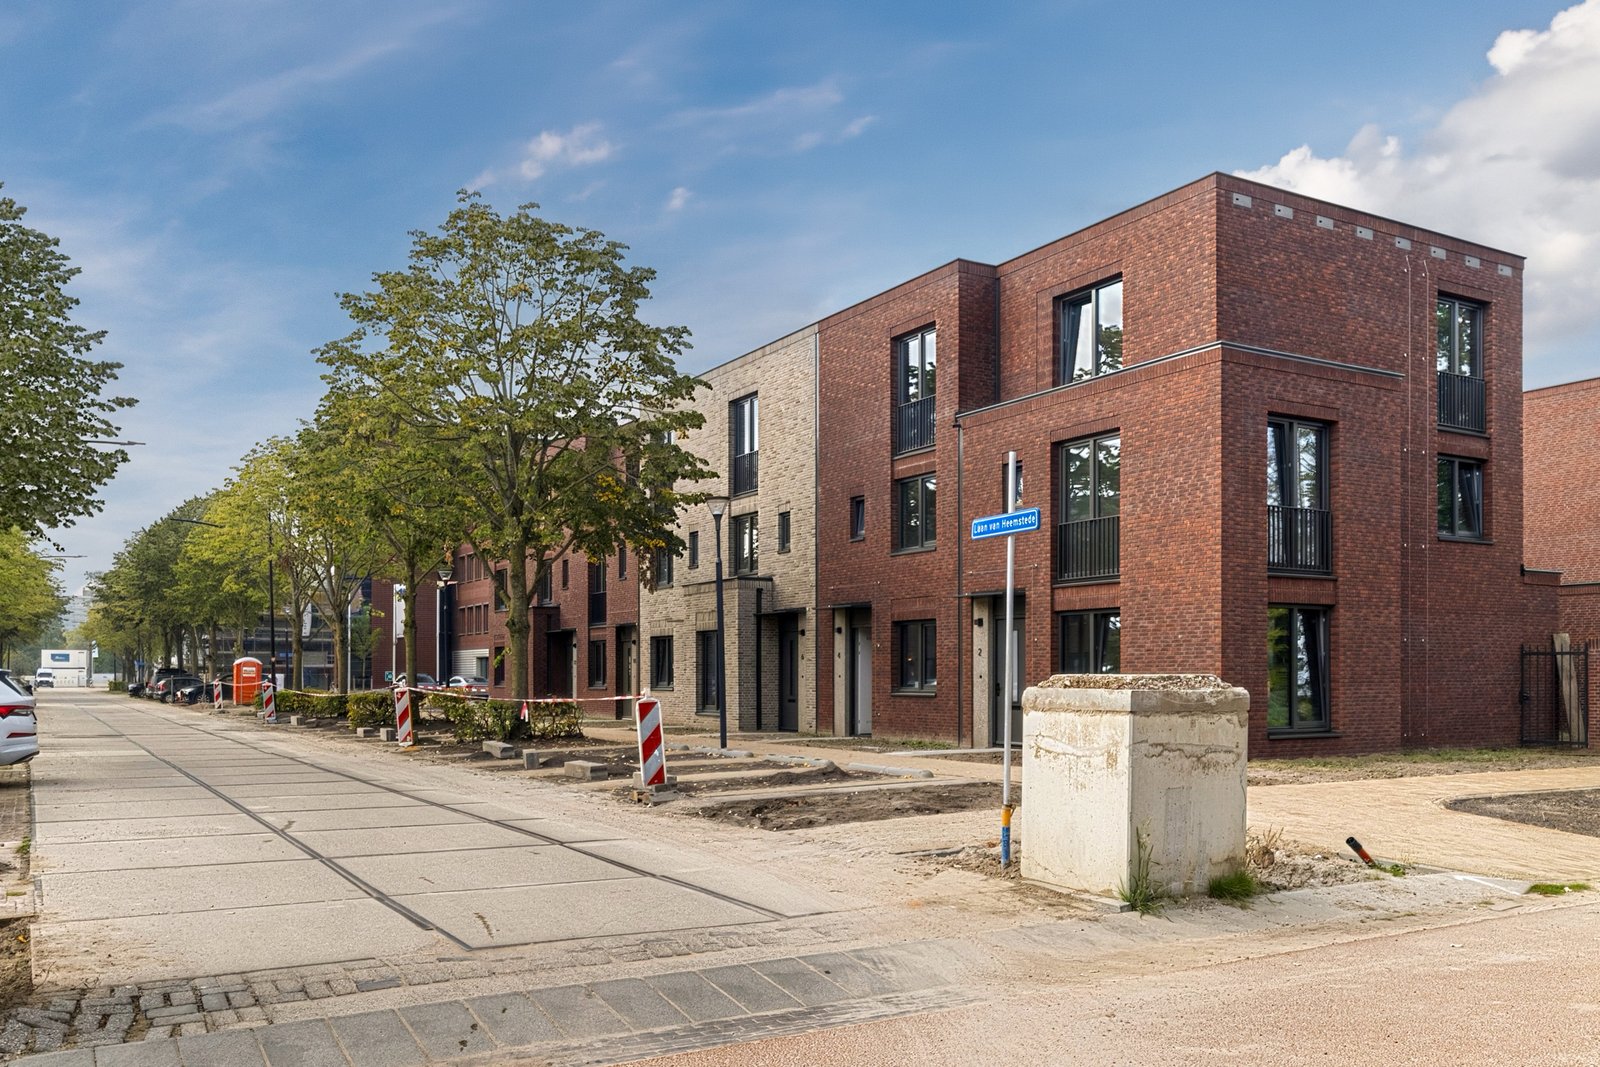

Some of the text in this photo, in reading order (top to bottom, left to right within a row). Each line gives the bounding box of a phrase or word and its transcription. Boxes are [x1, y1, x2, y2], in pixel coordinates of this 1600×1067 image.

[974, 515, 1036, 534] Laan van Heemstede
[977, 647, 983, 657] 2
